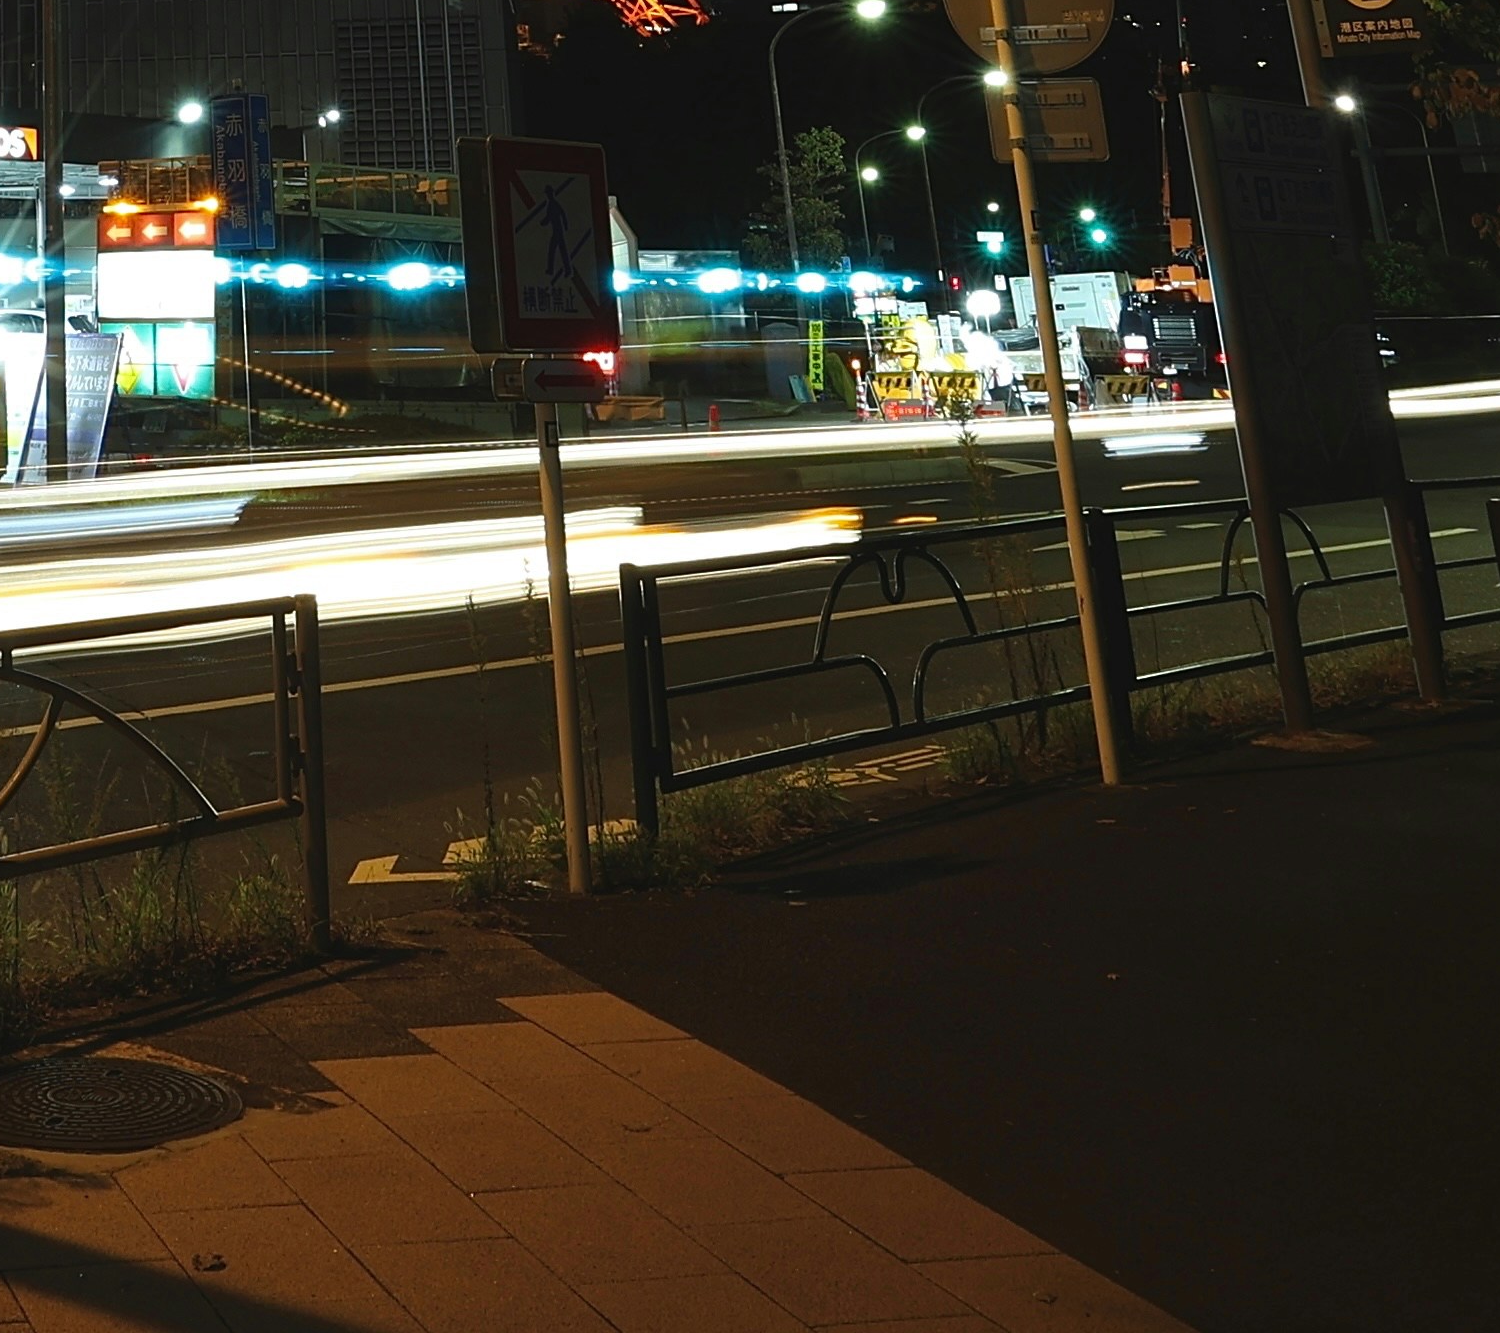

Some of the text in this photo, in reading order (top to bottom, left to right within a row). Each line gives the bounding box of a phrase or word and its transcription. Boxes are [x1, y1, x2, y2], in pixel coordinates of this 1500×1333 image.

[1340, 17, 1414, 33] 港区案内地図
[1336, 30, 1421, 43] Minato City Information Map
[224, 112, 248, 230] 赤羽橋
[523, 285, 579, 313] 横断禁止
